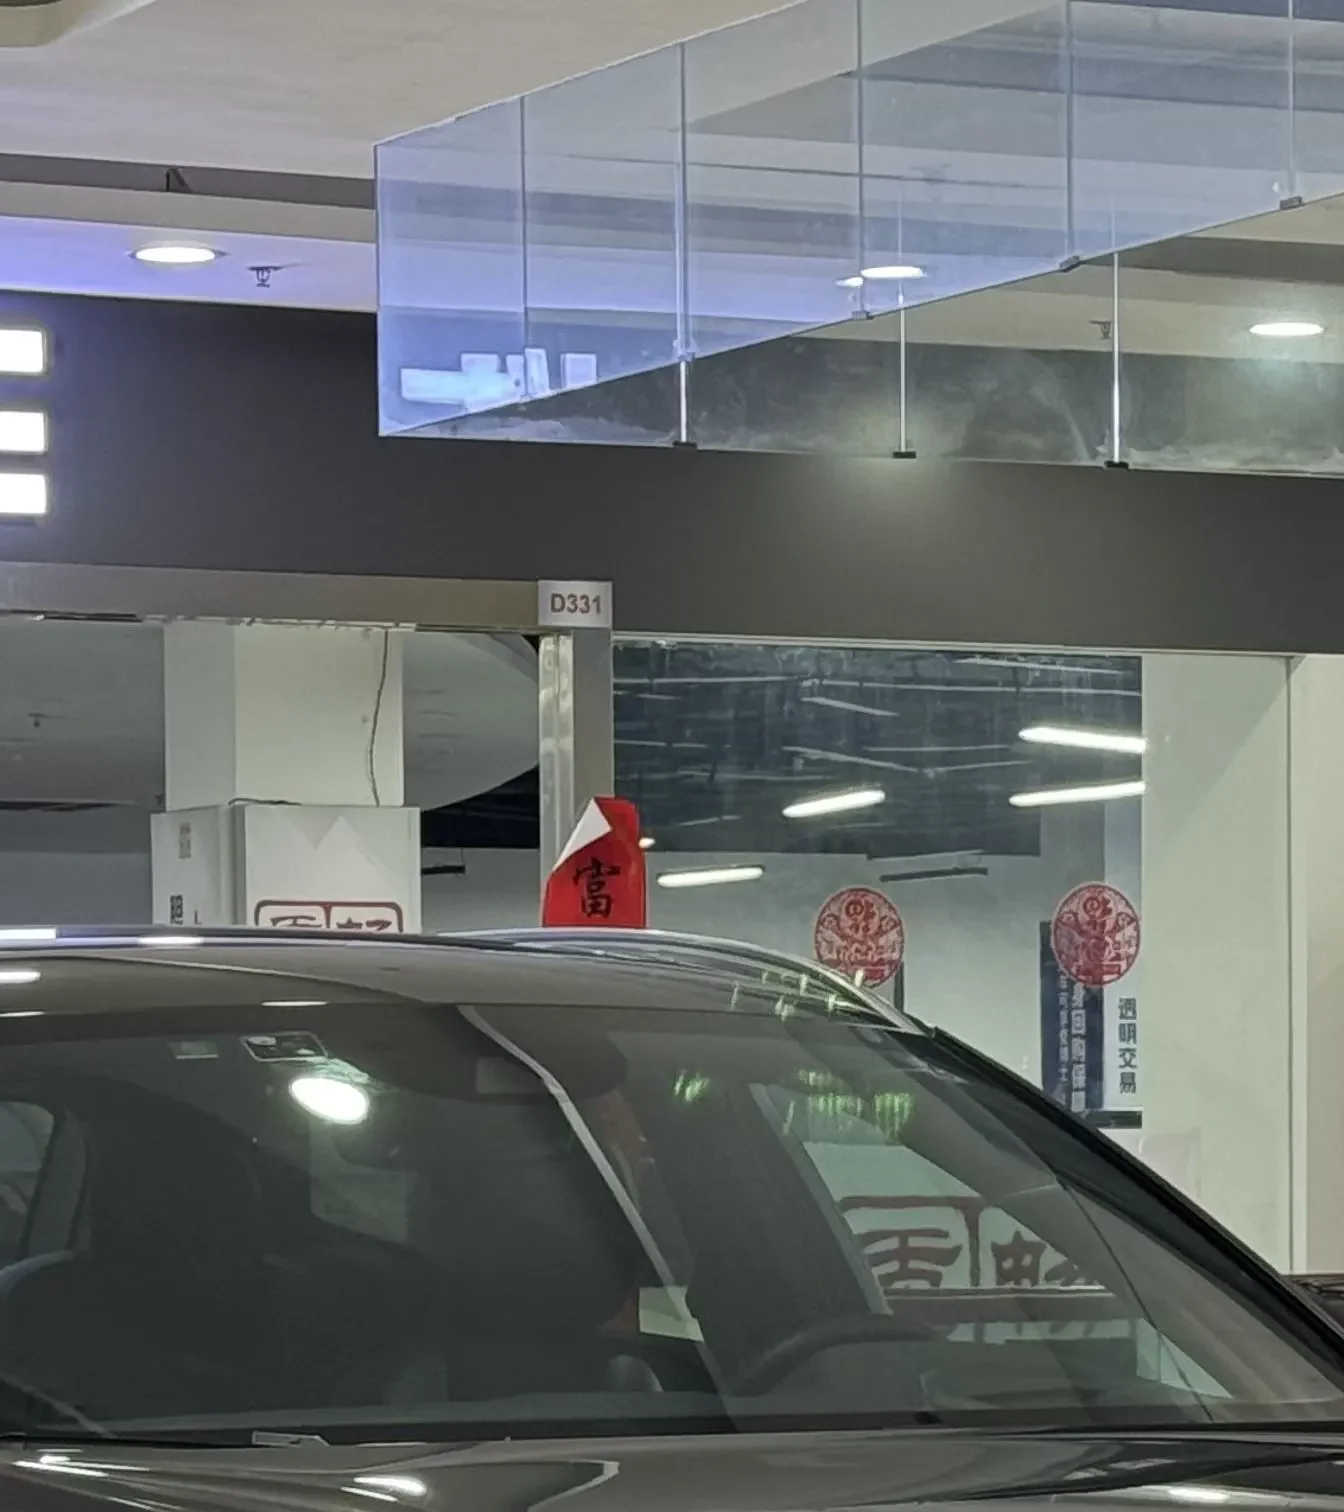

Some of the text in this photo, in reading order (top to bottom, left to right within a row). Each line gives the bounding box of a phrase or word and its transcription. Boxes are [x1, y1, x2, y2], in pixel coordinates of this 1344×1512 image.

[550, 592, 601, 614] D331
[1117, 997, 1139, 1094] 透明交易
